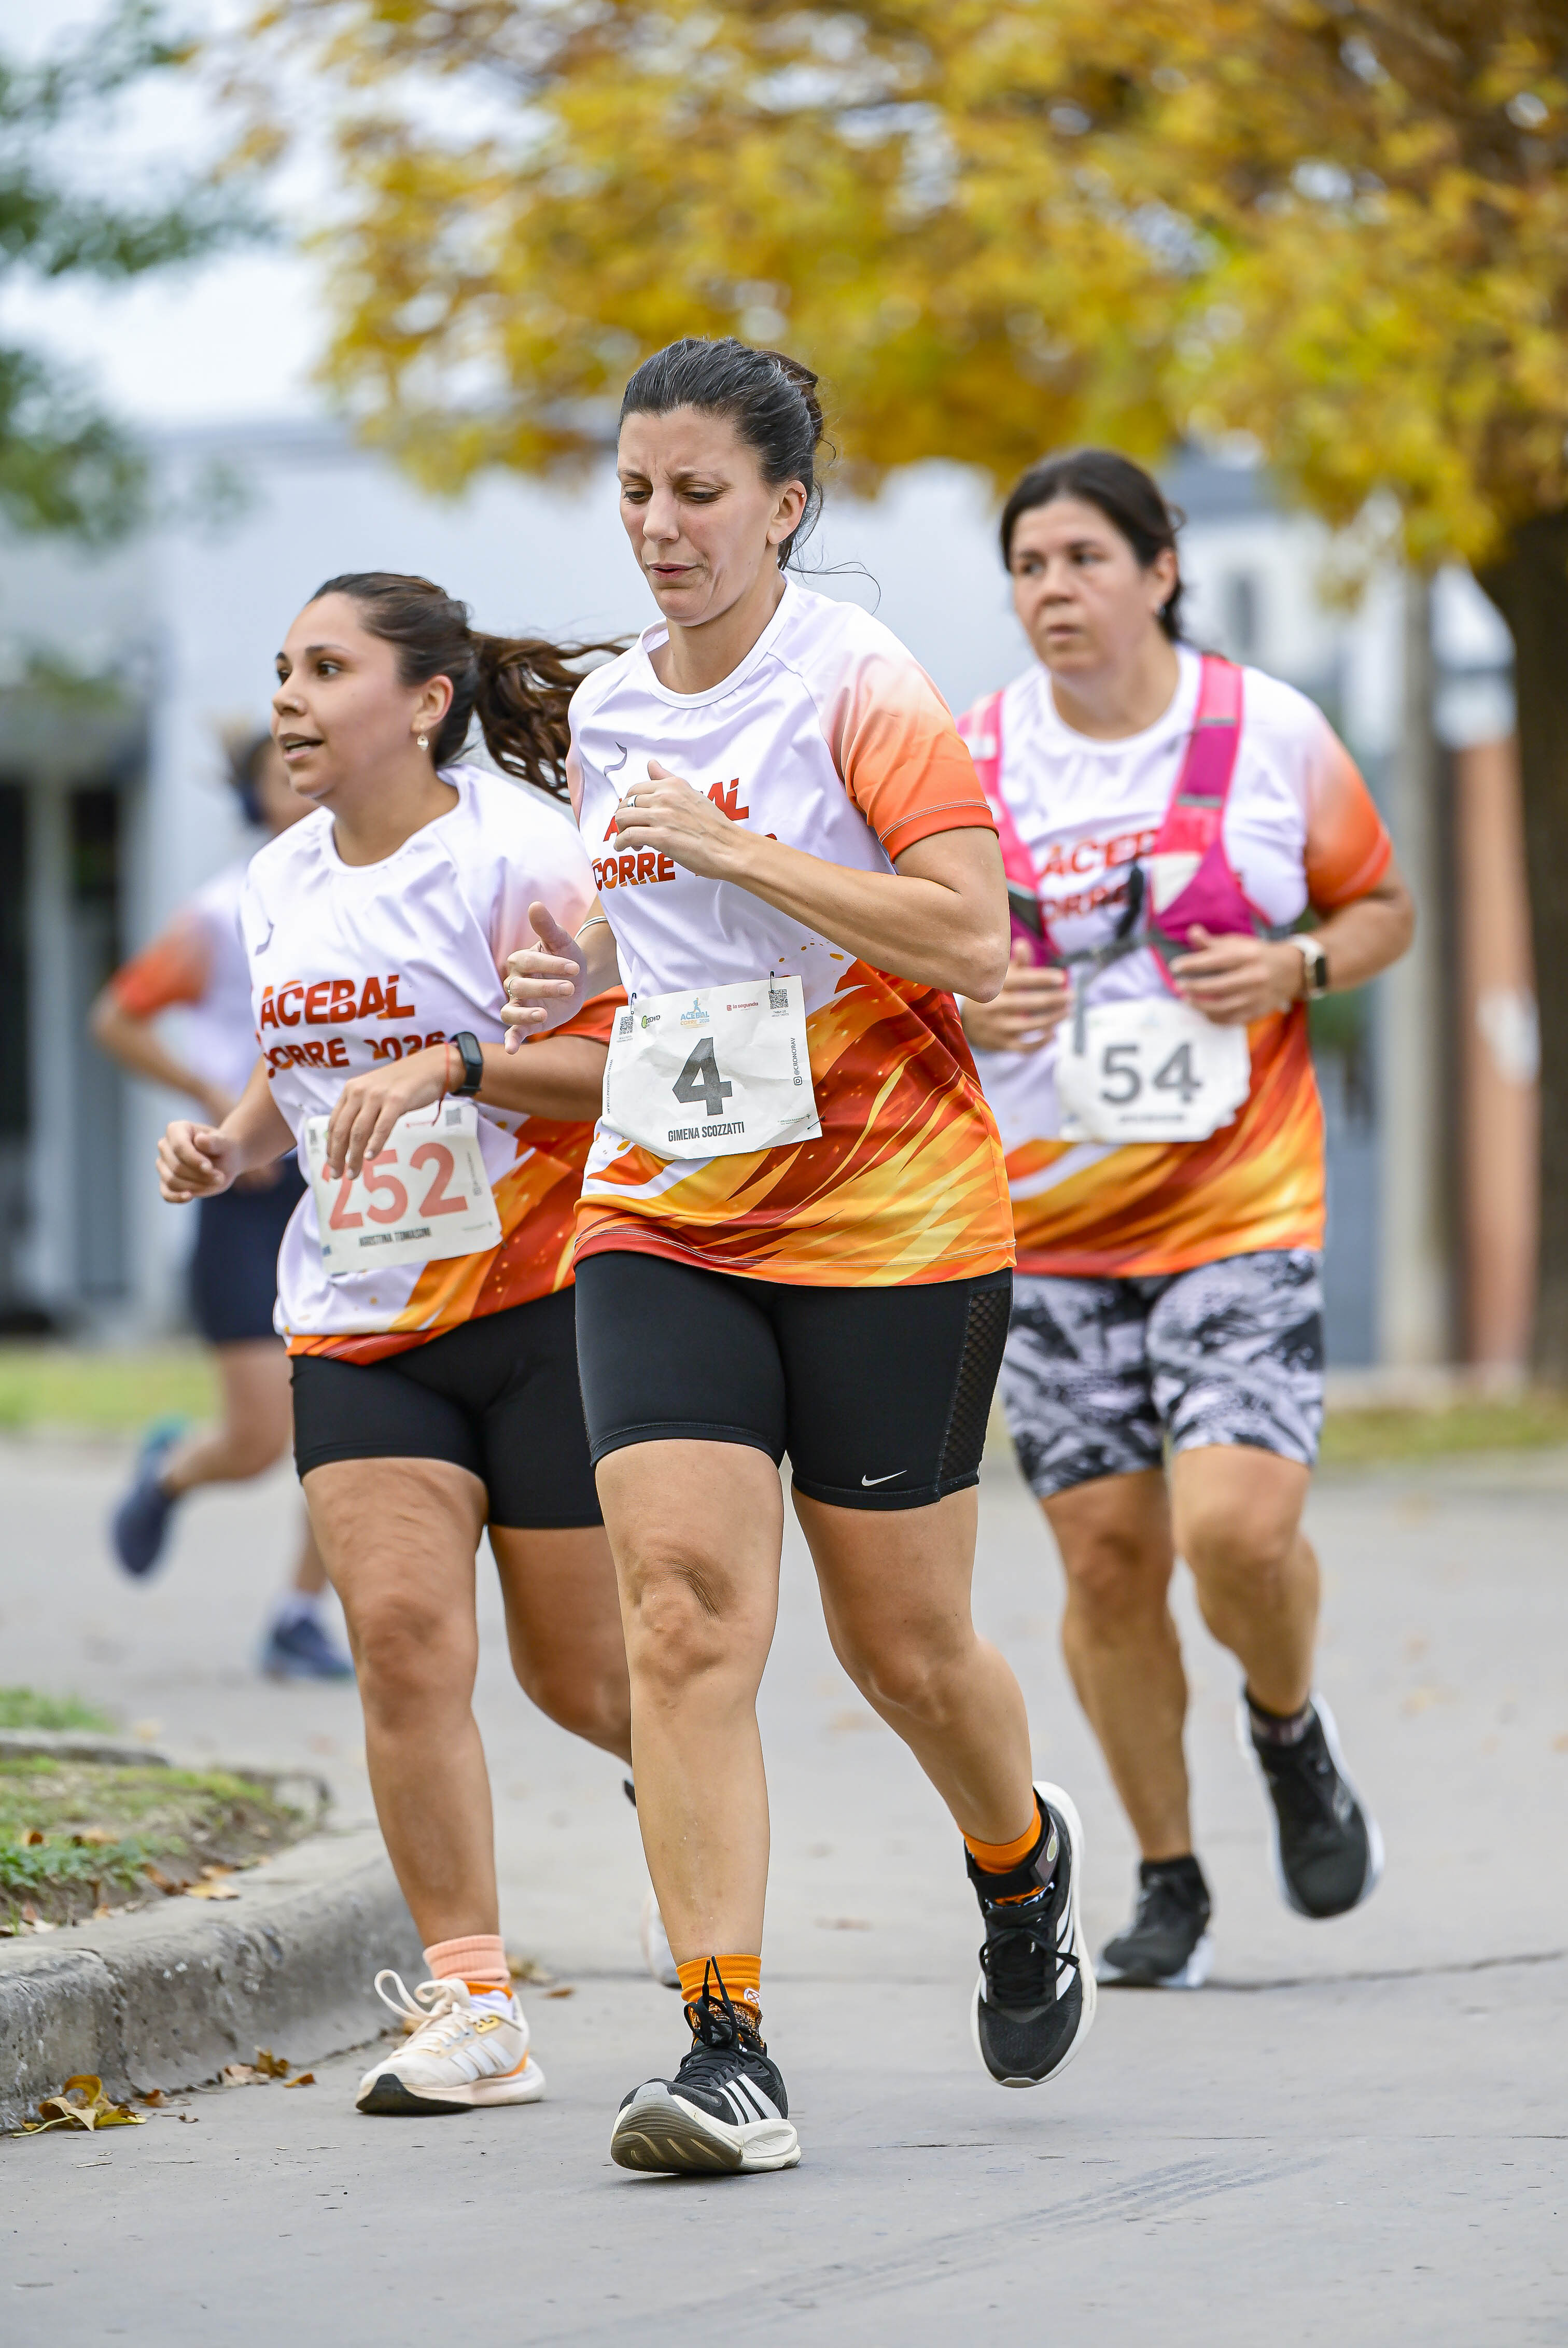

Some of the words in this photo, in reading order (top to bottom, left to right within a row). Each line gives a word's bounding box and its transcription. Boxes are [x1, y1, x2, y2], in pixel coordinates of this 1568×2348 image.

[592, 852, 676, 891] CORRE
[261, 974, 415, 1029] ACEBAL
[680, 1011, 710, 1021] ACEBAL
[672, 1037, 732, 1116] 4
[791, 1037, 800, 1075] @CRONORAV
[1100, 1041, 1203, 1105] 54
[668, 1127, 700, 1142] GIMENA
[702, 1122, 745, 1138] SCOZZATTI
[321, 1142, 469, 1231] 252
